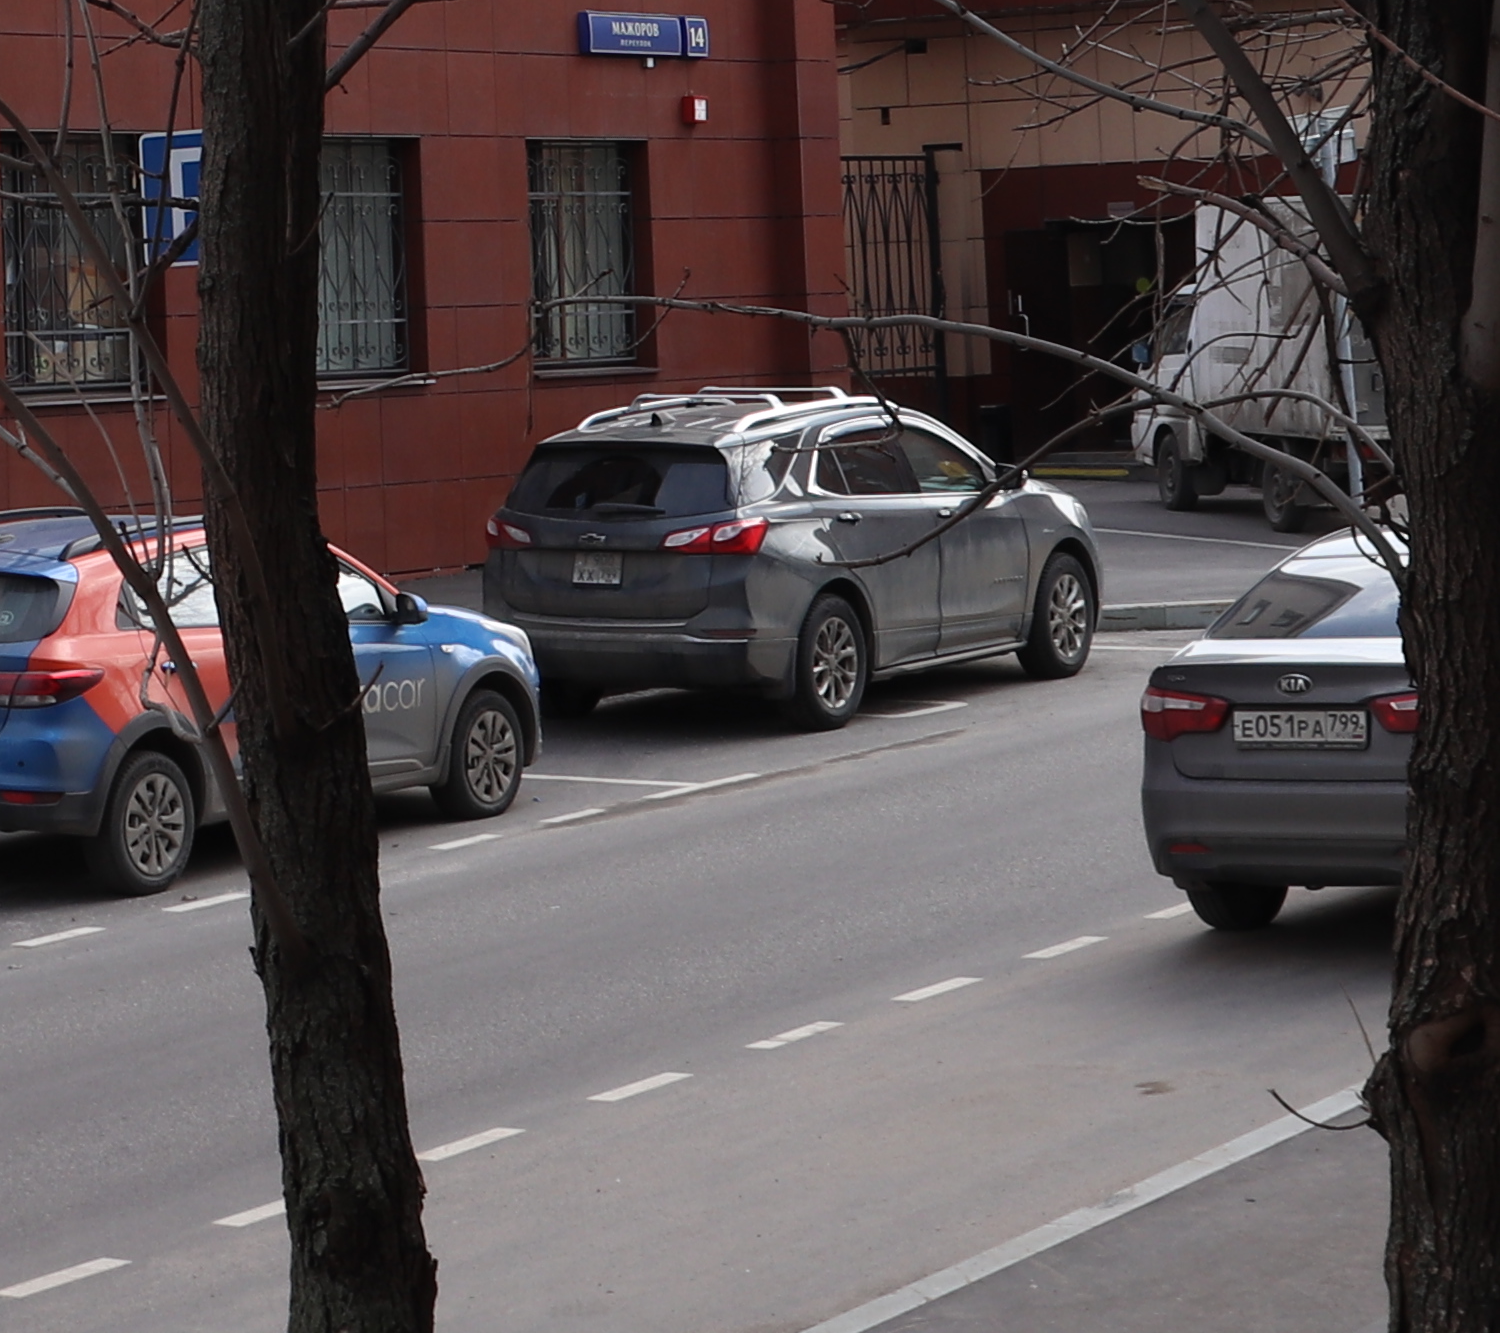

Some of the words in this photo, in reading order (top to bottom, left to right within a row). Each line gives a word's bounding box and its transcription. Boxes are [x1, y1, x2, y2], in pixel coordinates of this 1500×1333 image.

[611, 21, 660, 37] МАЖОРОВ
[690, 27, 704, 48] 14
[1280, 679, 1307, 692] KIA
[1241, 714, 1326, 739] Е051РА
[1328, 713, 1360, 733] 799
